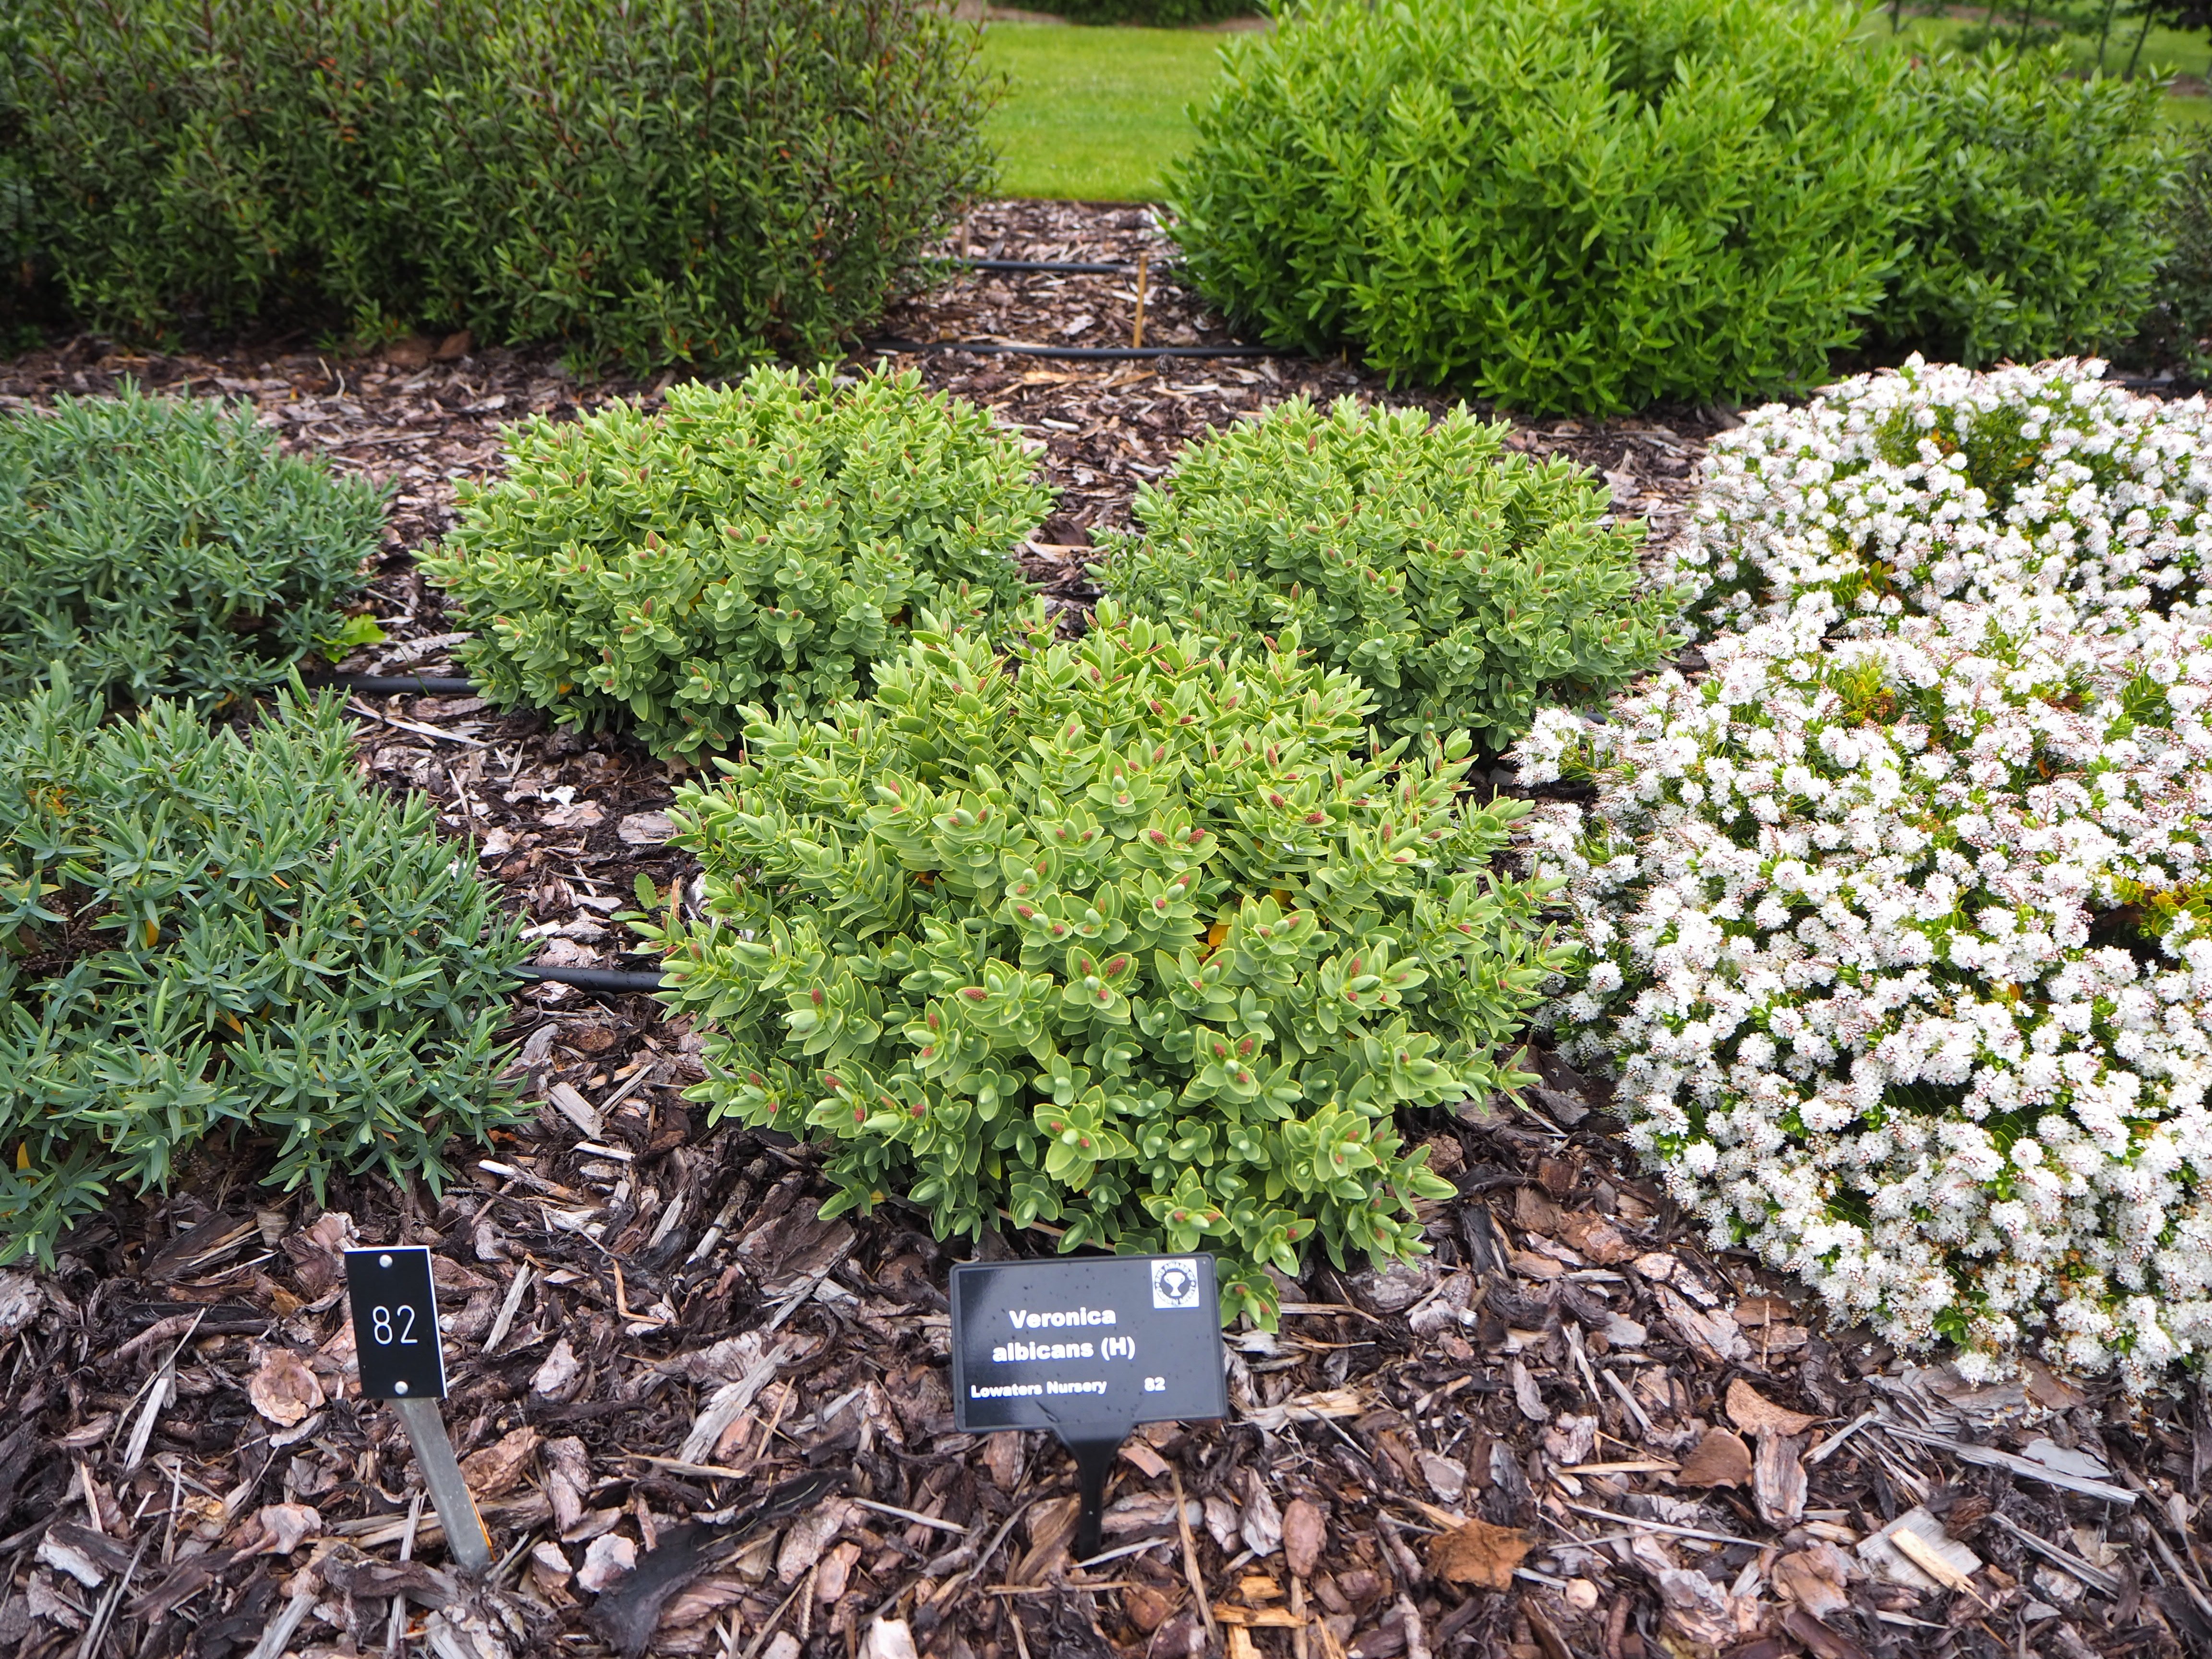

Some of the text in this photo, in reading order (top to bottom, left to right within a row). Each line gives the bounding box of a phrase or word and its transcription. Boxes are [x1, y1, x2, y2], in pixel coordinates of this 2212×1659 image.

[373, 1305, 418, 1345] 82
[1009, 1307, 1117, 1329] Veronica
[992, 1336, 1136, 1362] albicans (H)
[971, 1381, 1107, 1398] Lowaters Nursery
[1144, 1376, 1166, 1392] 82
